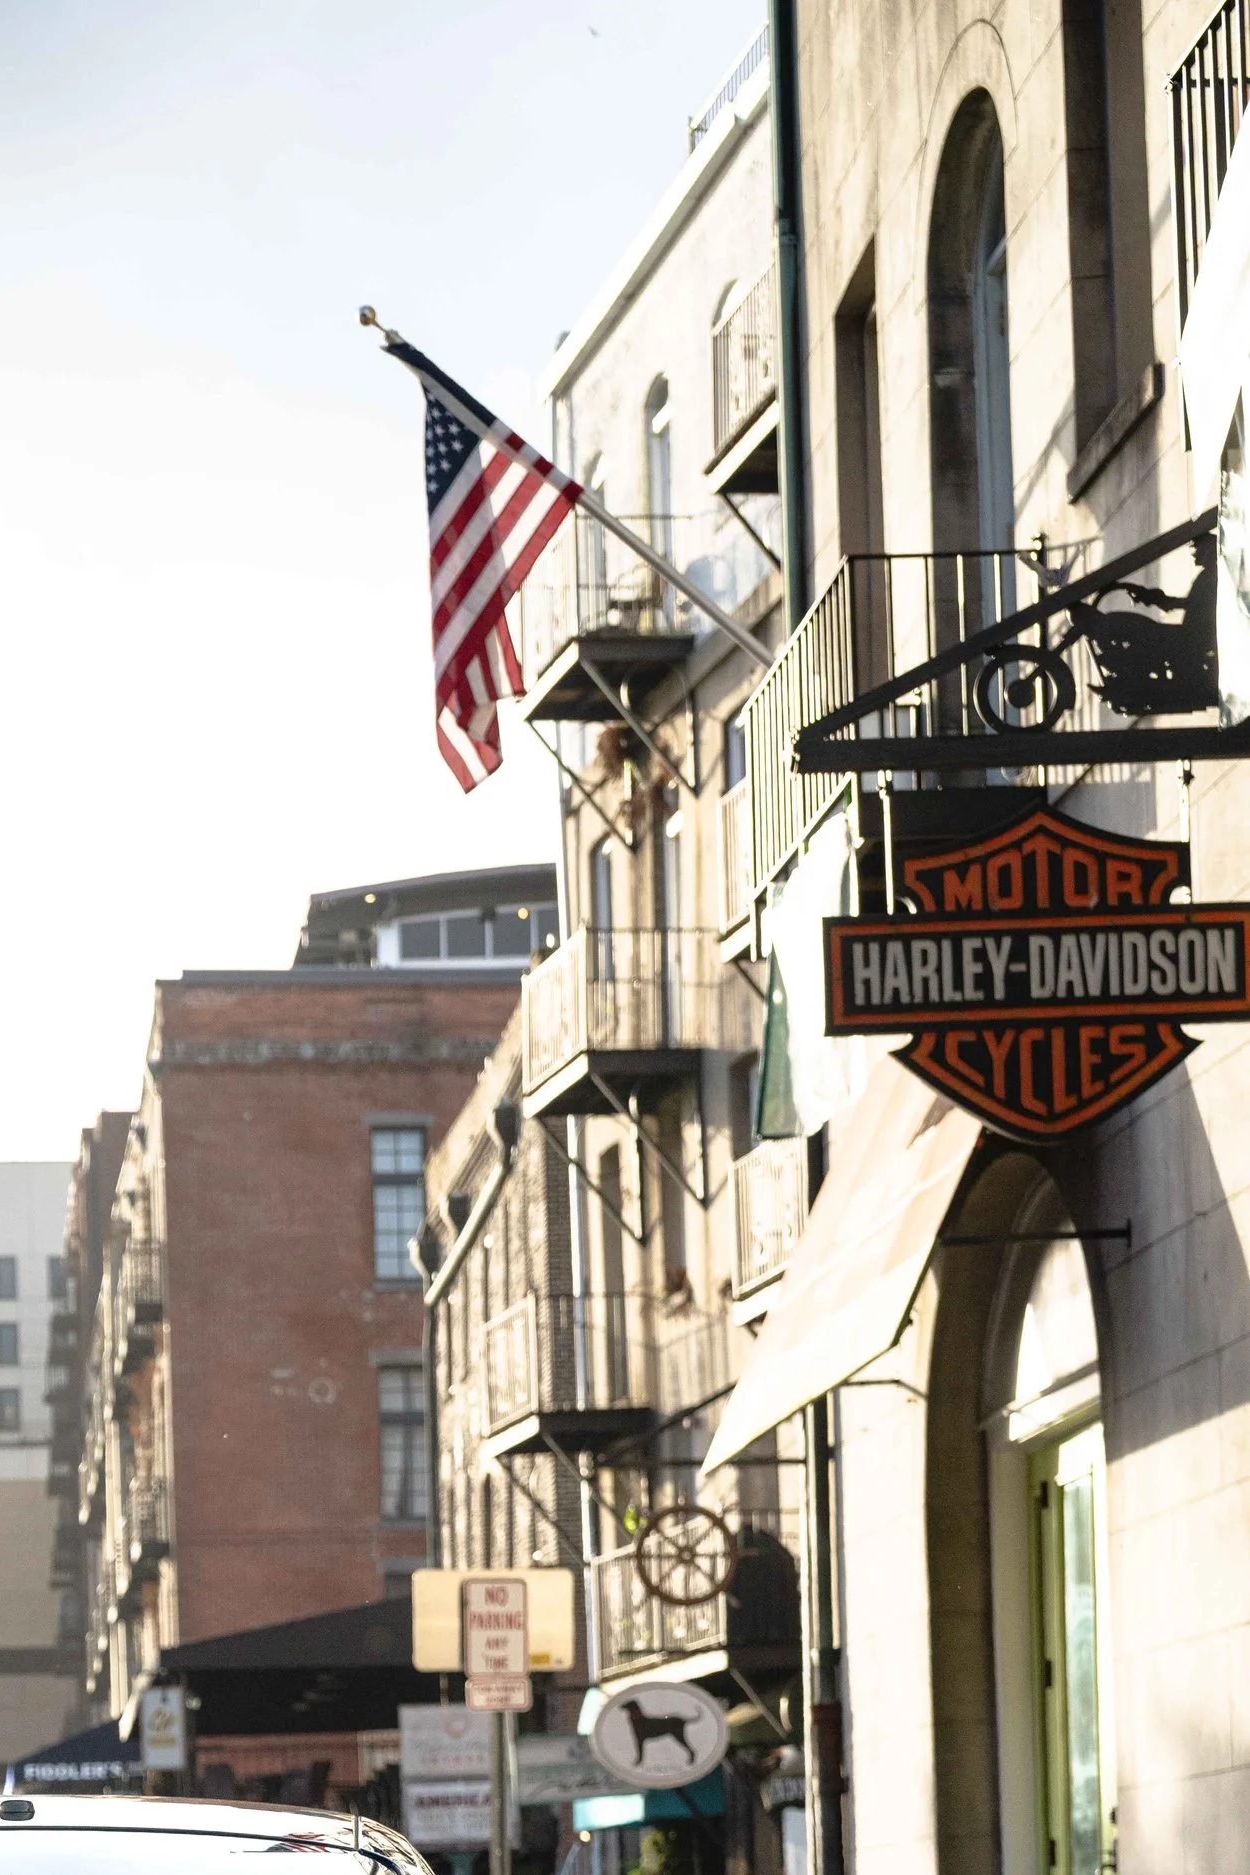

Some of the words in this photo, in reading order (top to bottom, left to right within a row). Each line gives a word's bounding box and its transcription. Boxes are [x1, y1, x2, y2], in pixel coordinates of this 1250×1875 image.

[943, 832, 1142, 912] MOTOR
[852, 928, 1237, 1006] HARLEY-DAVIDSON
[945, 1023, 1147, 1117] CYCLES
[485, 1586, 507, 1606] NO
[469, 1611, 523, 1630] PARKING
[485, 1637, 507, 1650] ANY
[484, 1654, 507, 1669] TIME
[23, 1762, 123, 1781] FIDDLER'S
